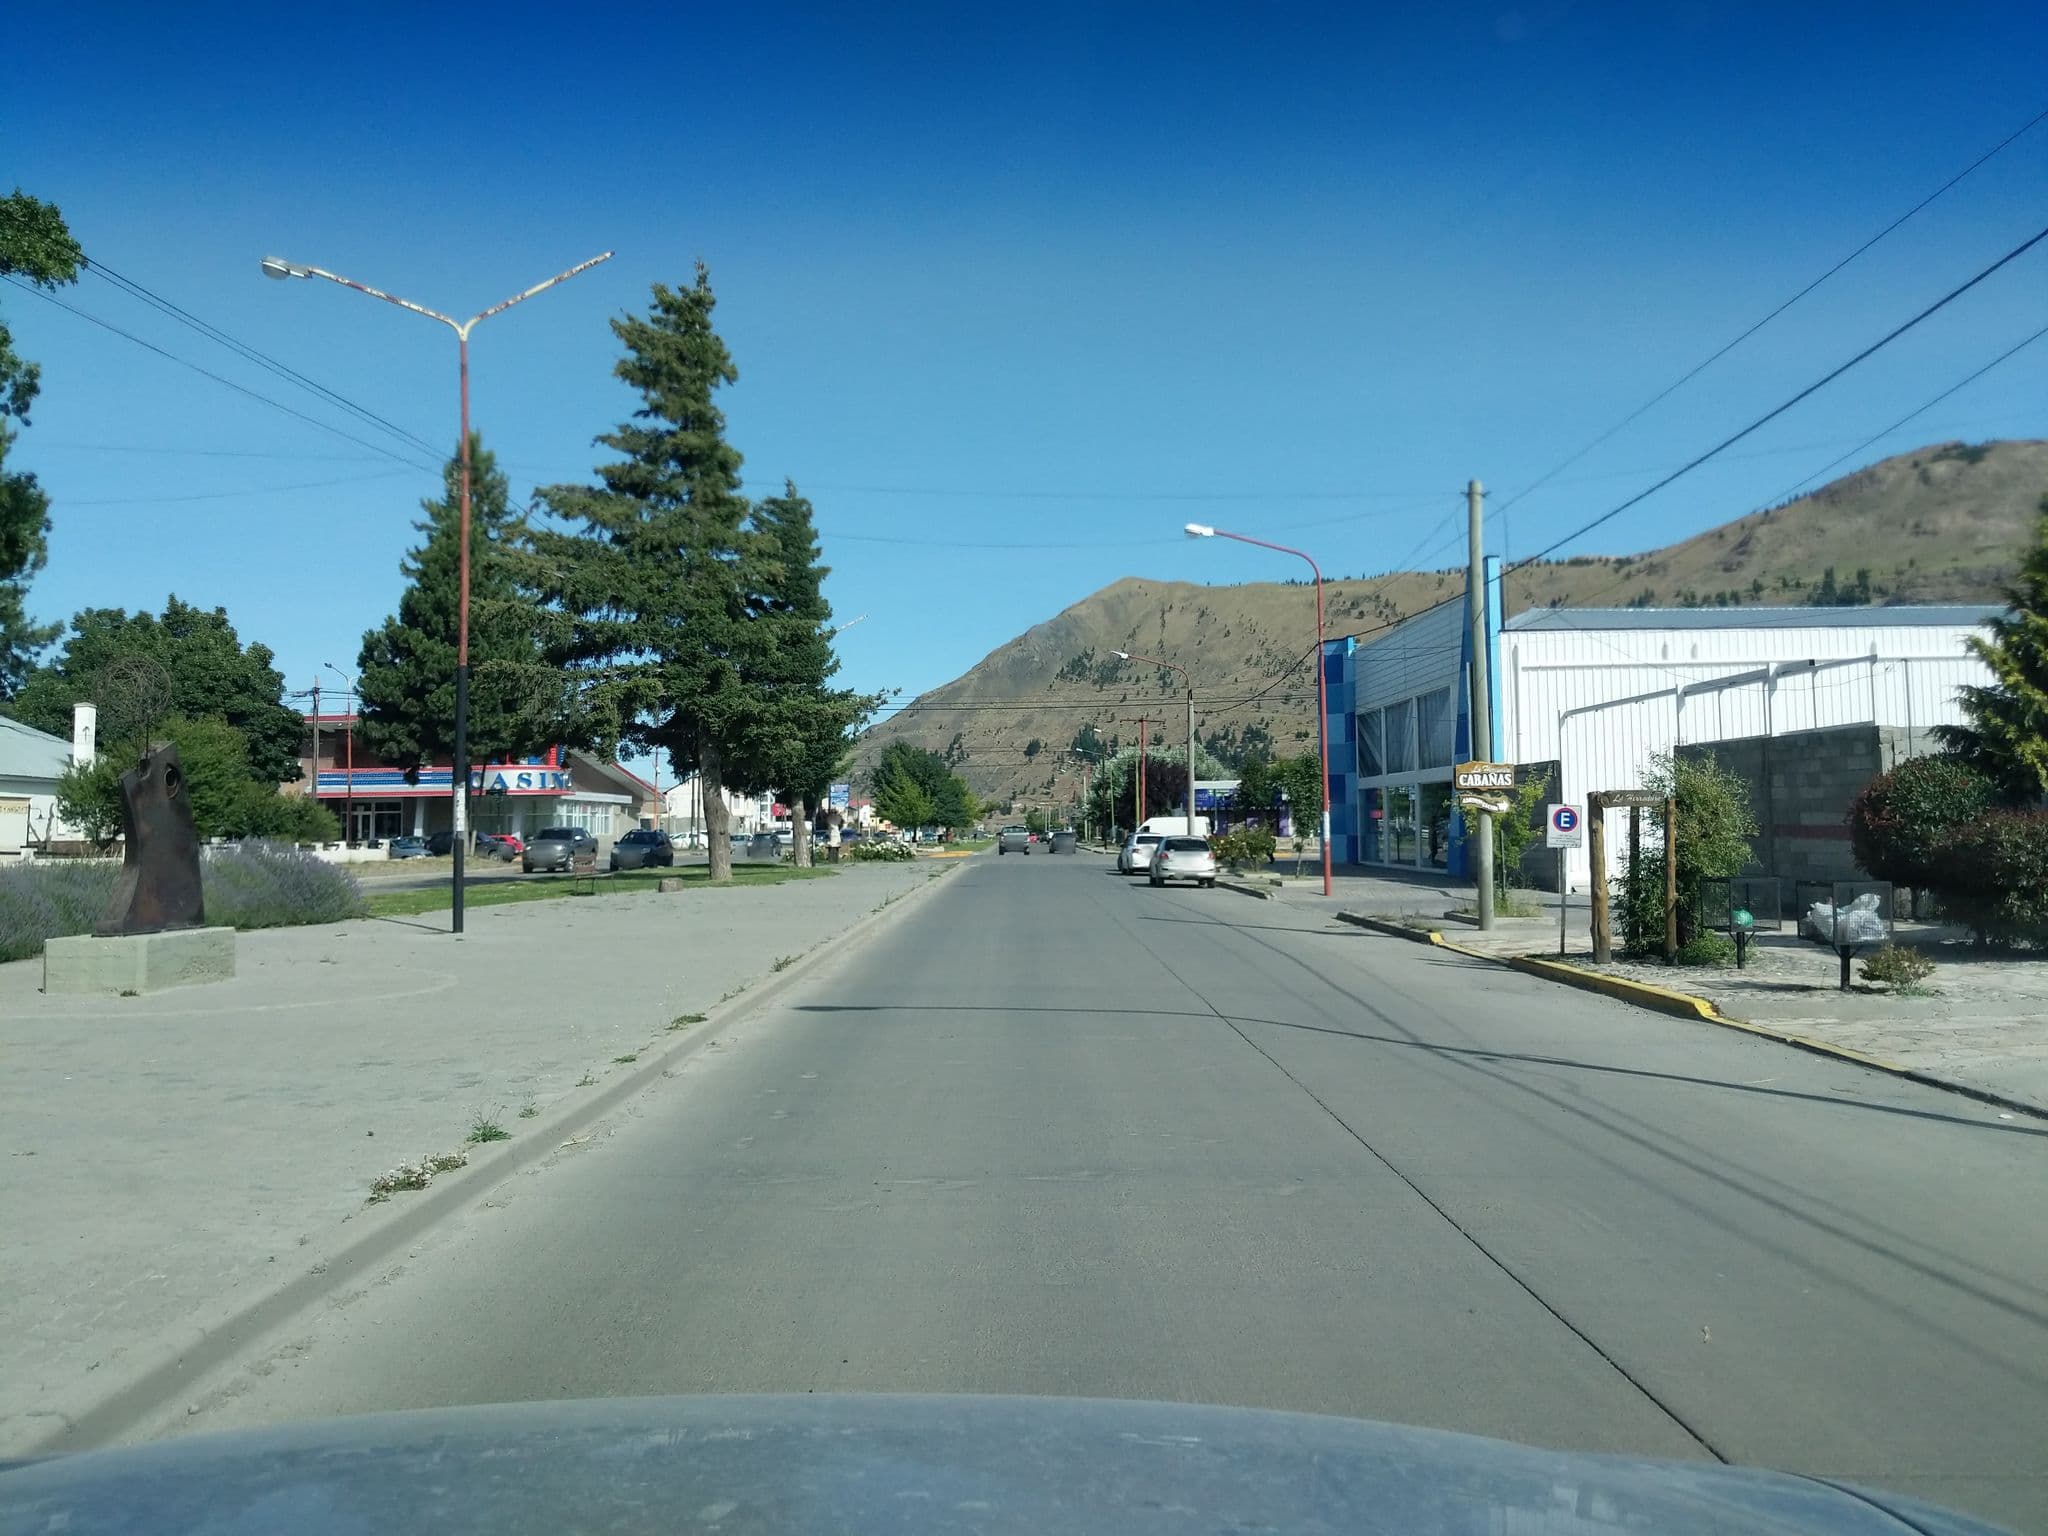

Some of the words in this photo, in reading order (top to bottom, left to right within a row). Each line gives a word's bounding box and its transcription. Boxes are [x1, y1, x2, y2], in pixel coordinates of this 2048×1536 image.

[470, 771, 573, 789] CASIN
[1459, 772, 1512, 786] CABAÑAS
[1560, 812, 1571, 828] E
